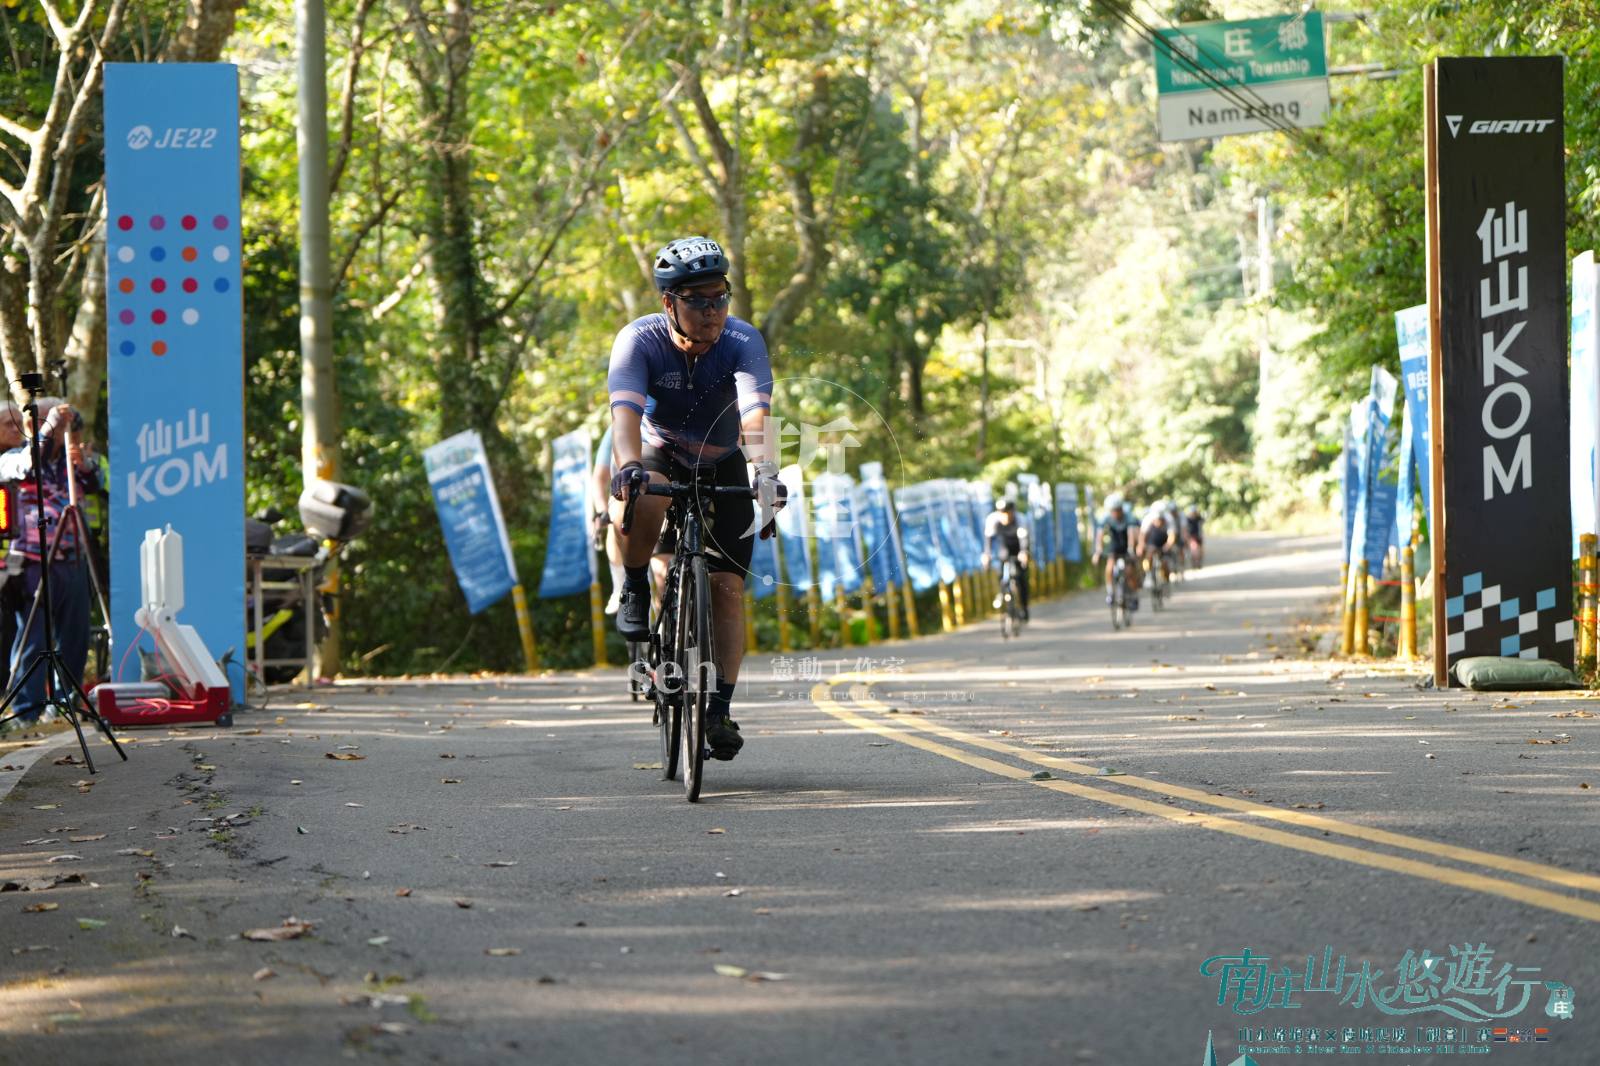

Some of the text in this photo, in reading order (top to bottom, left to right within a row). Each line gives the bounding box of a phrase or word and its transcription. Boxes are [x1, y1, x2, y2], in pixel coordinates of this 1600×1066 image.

[1248, 57, 1311, 77] Township
[1468, 119, 1556, 134] GIANT
[154, 127, 218, 149] JE22
[135, 407, 210, 464] 仙山
[127, 442, 229, 508] KOM
